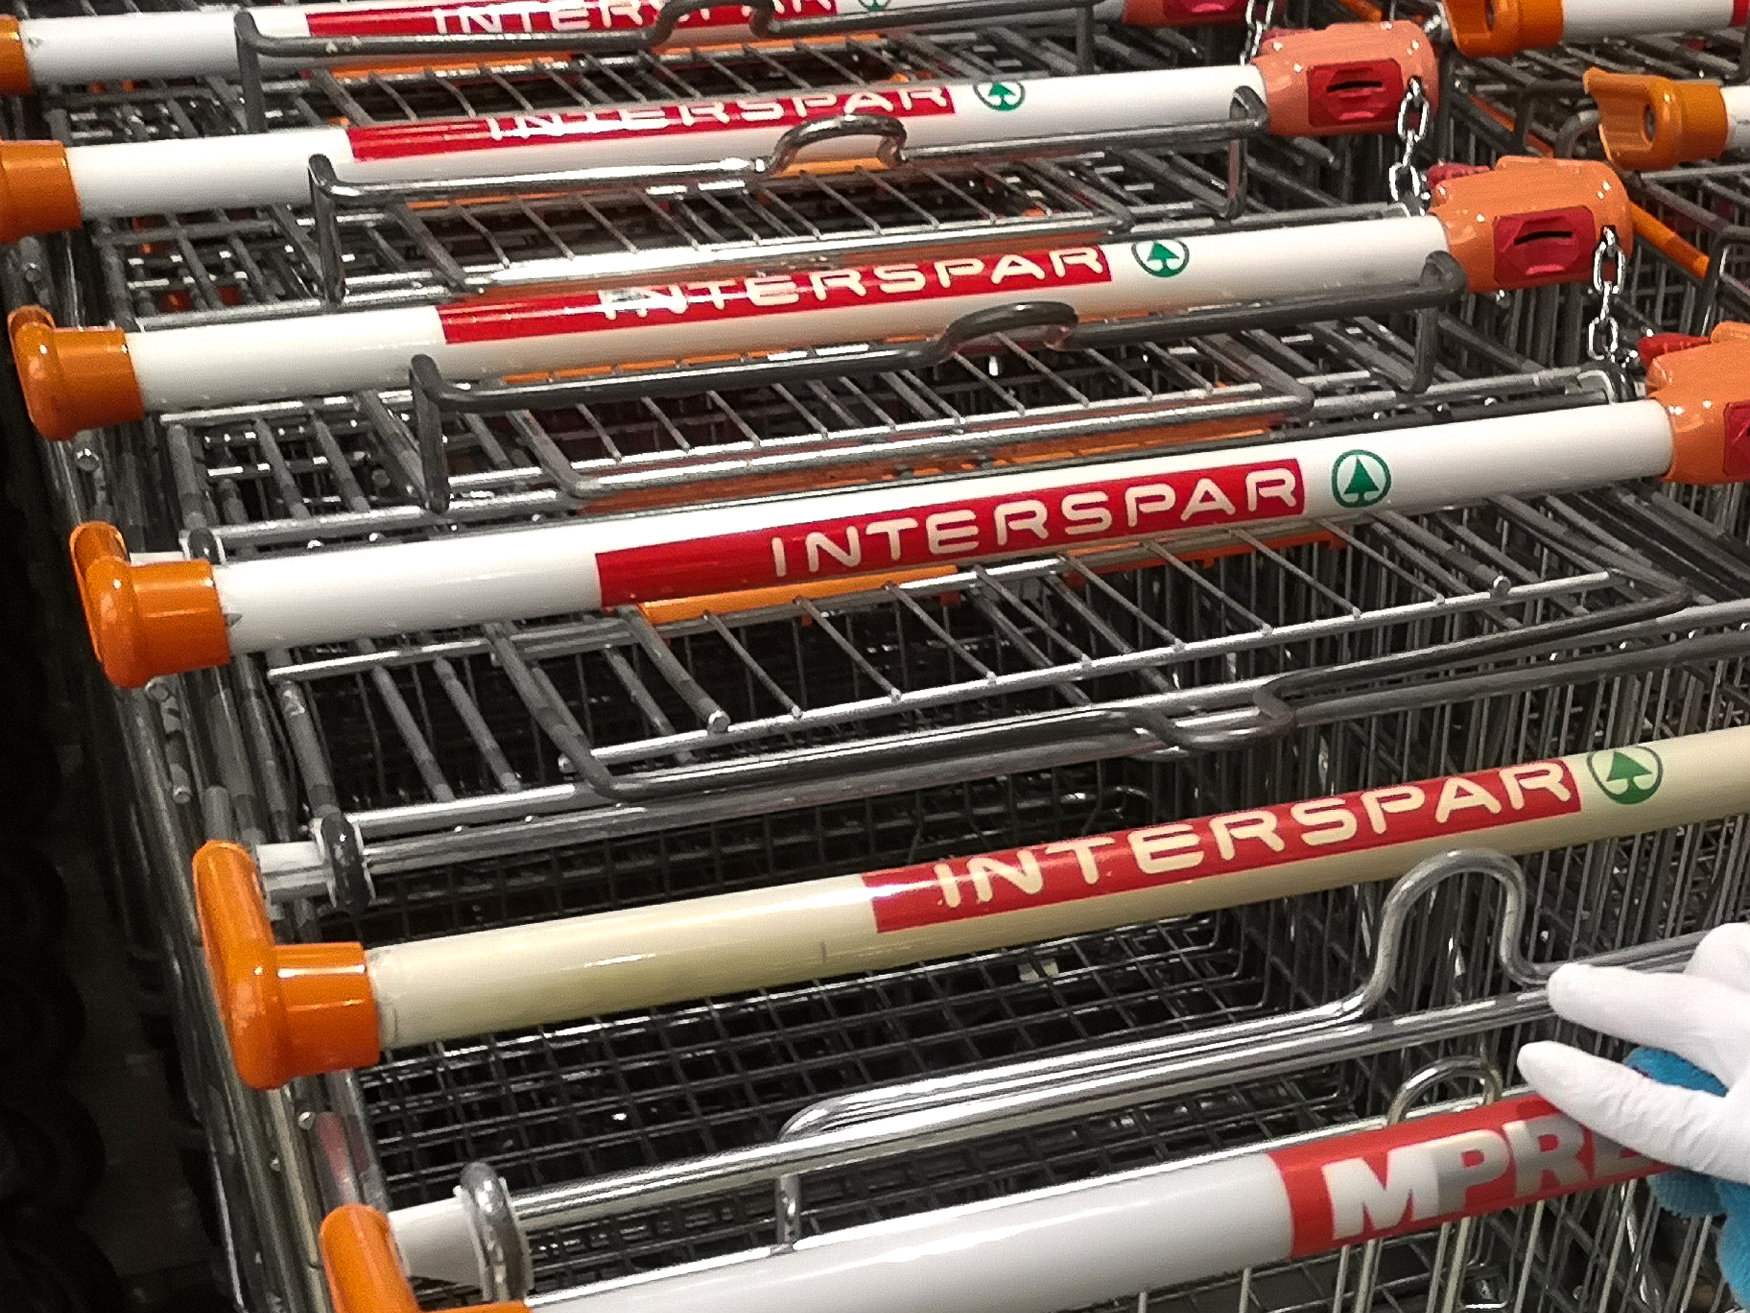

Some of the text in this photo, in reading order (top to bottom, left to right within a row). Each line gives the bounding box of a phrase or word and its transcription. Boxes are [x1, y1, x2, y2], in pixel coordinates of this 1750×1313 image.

[486, 86, 948, 141] INTERSPAR
[597, 245, 1104, 320] INTERSPAR
[770, 467, 1297, 577] INTERSPAR
[933, 761, 1572, 908] INTERSPAR
